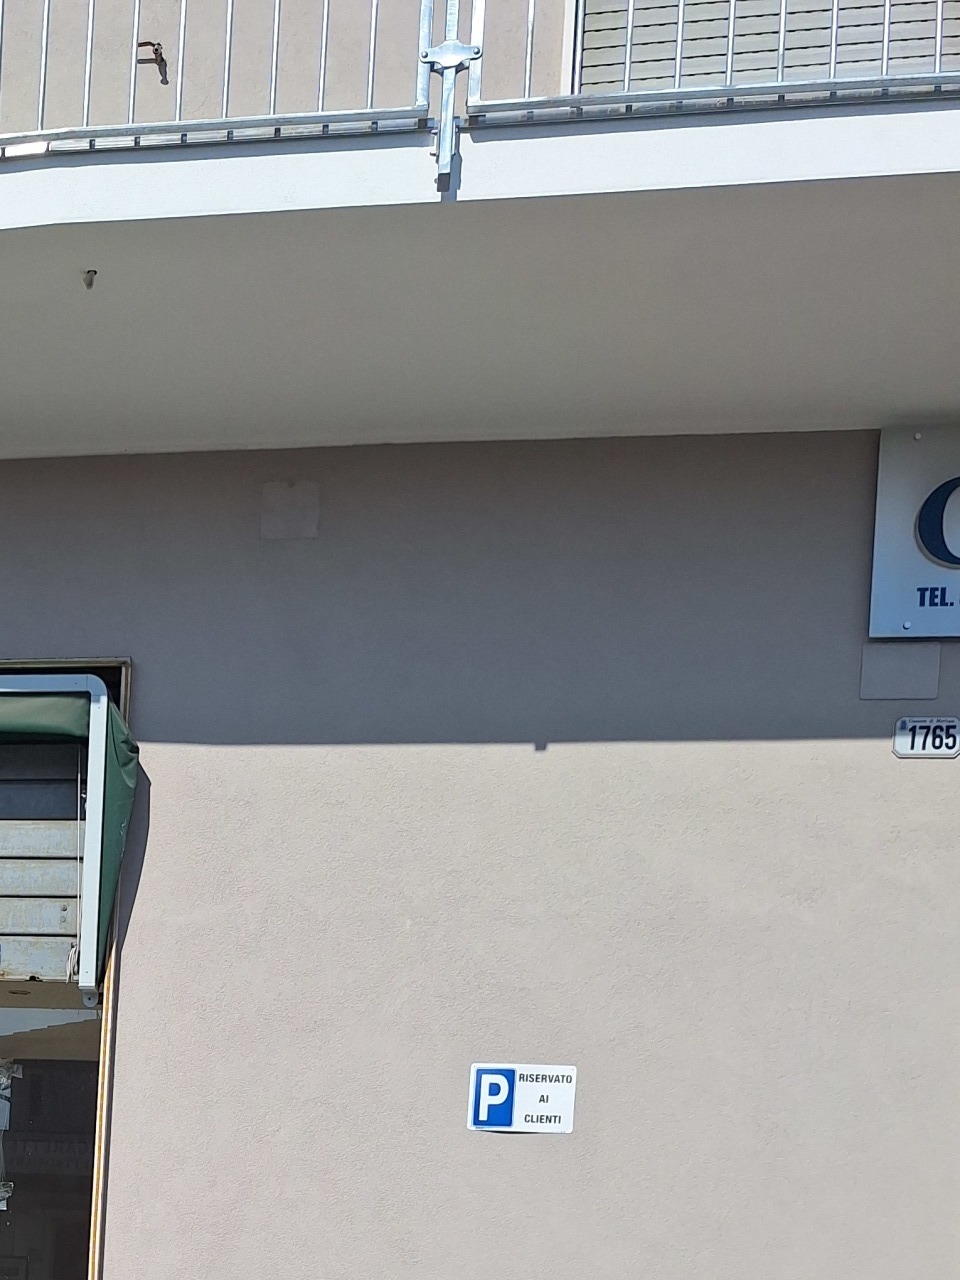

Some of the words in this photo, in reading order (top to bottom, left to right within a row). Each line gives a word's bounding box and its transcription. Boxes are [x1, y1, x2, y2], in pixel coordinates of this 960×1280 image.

[916, 586, 955, 607] TEL.
[908, 724, 957, 751] 1765
[518, 1073, 573, 1084] RISERVATO
[538, 1094, 549, 1104] AI
[524, 1114, 562, 1125] CLIENTI
